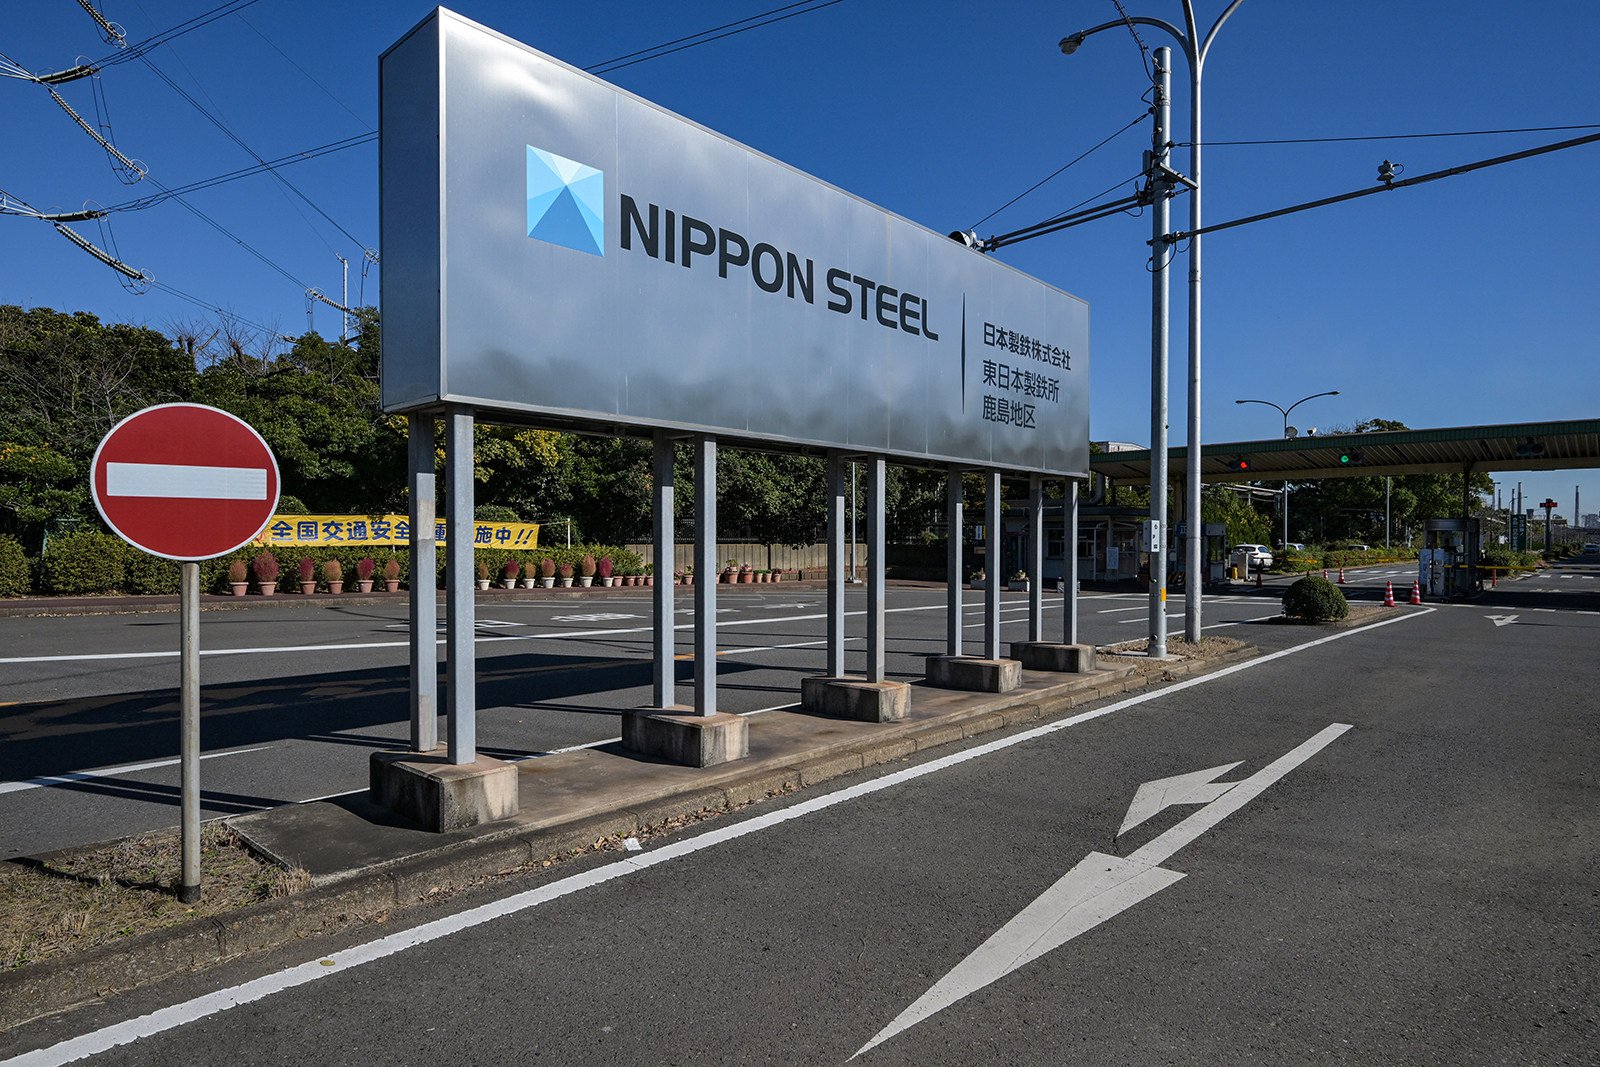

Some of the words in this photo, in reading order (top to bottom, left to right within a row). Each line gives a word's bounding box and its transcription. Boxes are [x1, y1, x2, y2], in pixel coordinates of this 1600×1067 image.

[620, 193, 814, 305] NIPPON
[826, 267, 939, 342] STEEL
[983, 321, 1071, 371] 日本製鉄株式会社
[982, 359, 1060, 404] 東日本製鉄所
[982, 394, 1036, 429] 鹿島地区
